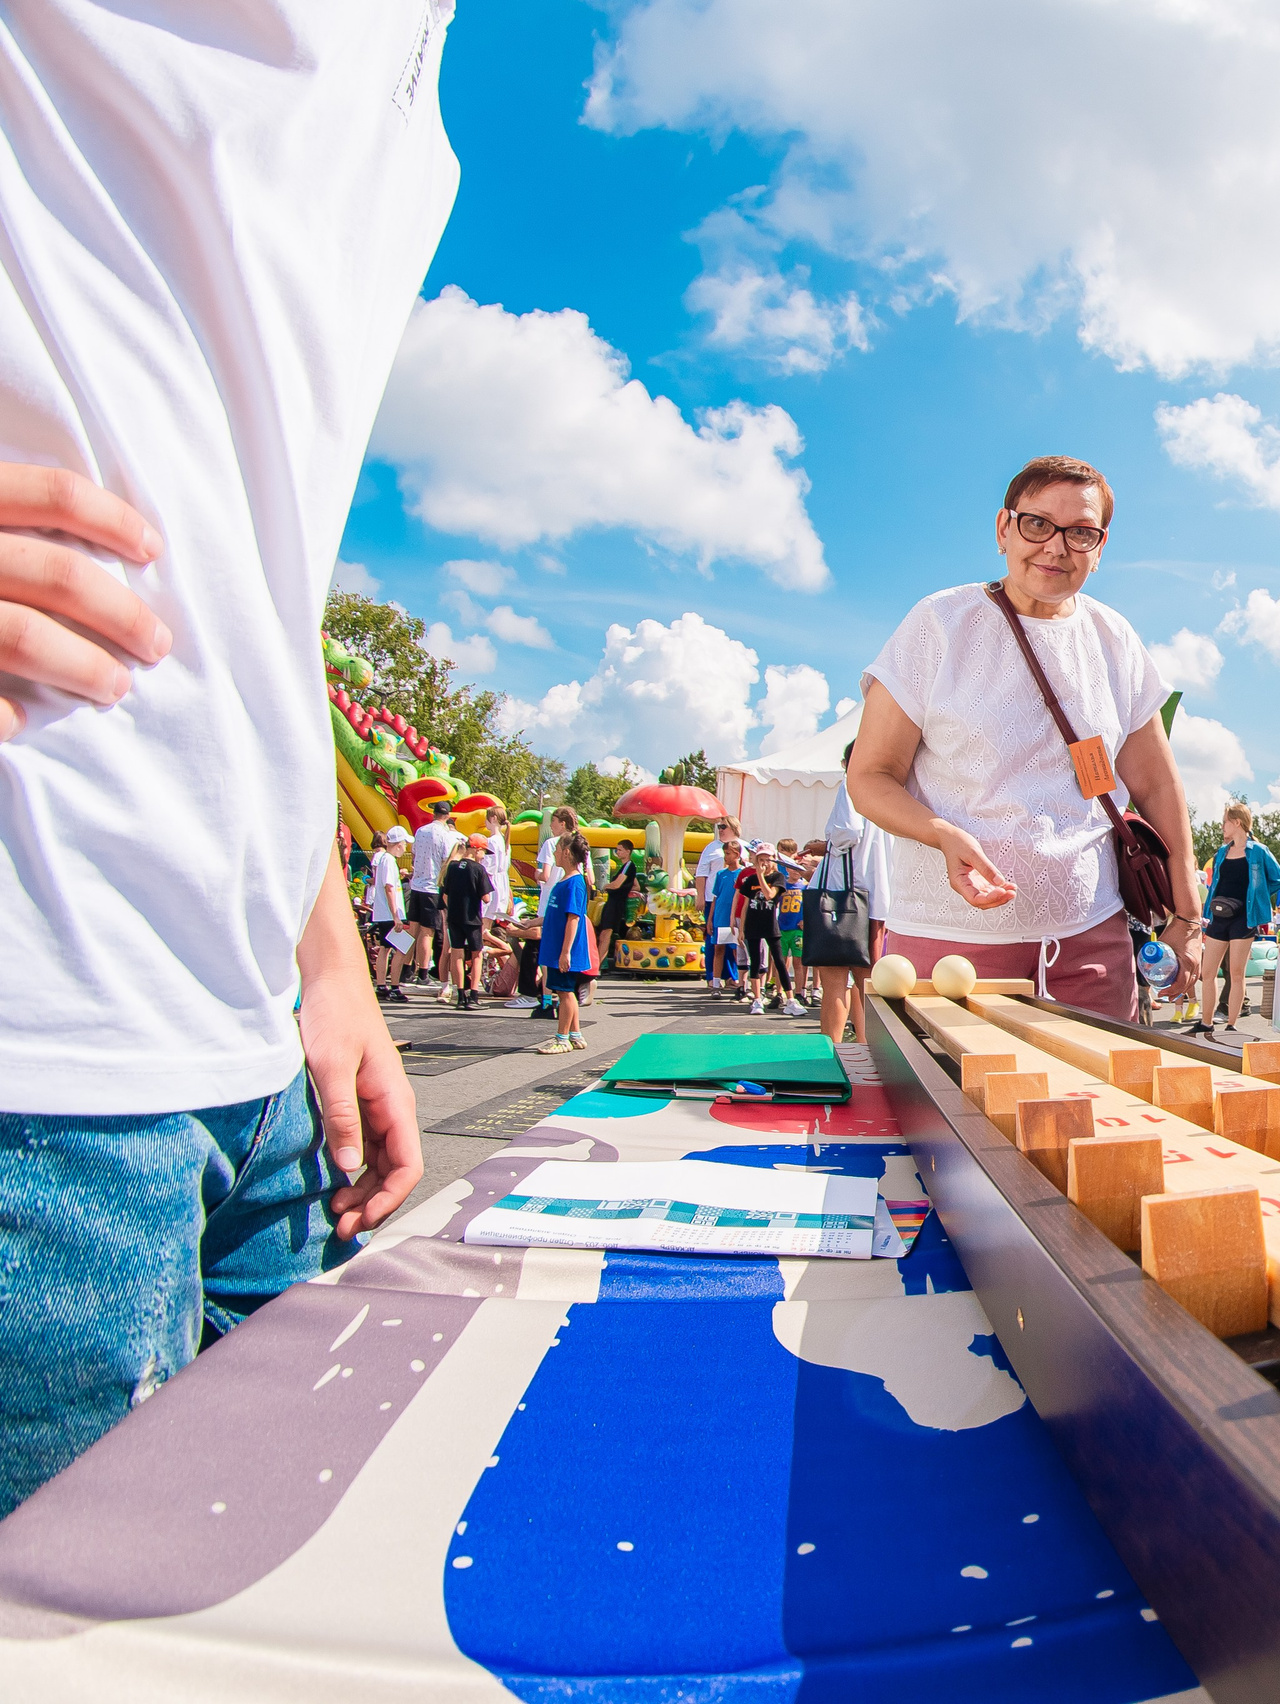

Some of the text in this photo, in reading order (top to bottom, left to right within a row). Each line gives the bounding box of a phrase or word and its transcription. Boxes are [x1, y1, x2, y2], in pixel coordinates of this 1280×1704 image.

[781, 896, 802, 913] 86
[1095, 1114, 1167, 1127] 10
[480, 1230, 548, 1244] профориентации
[549, 1237, 575, 1247] Отдел
